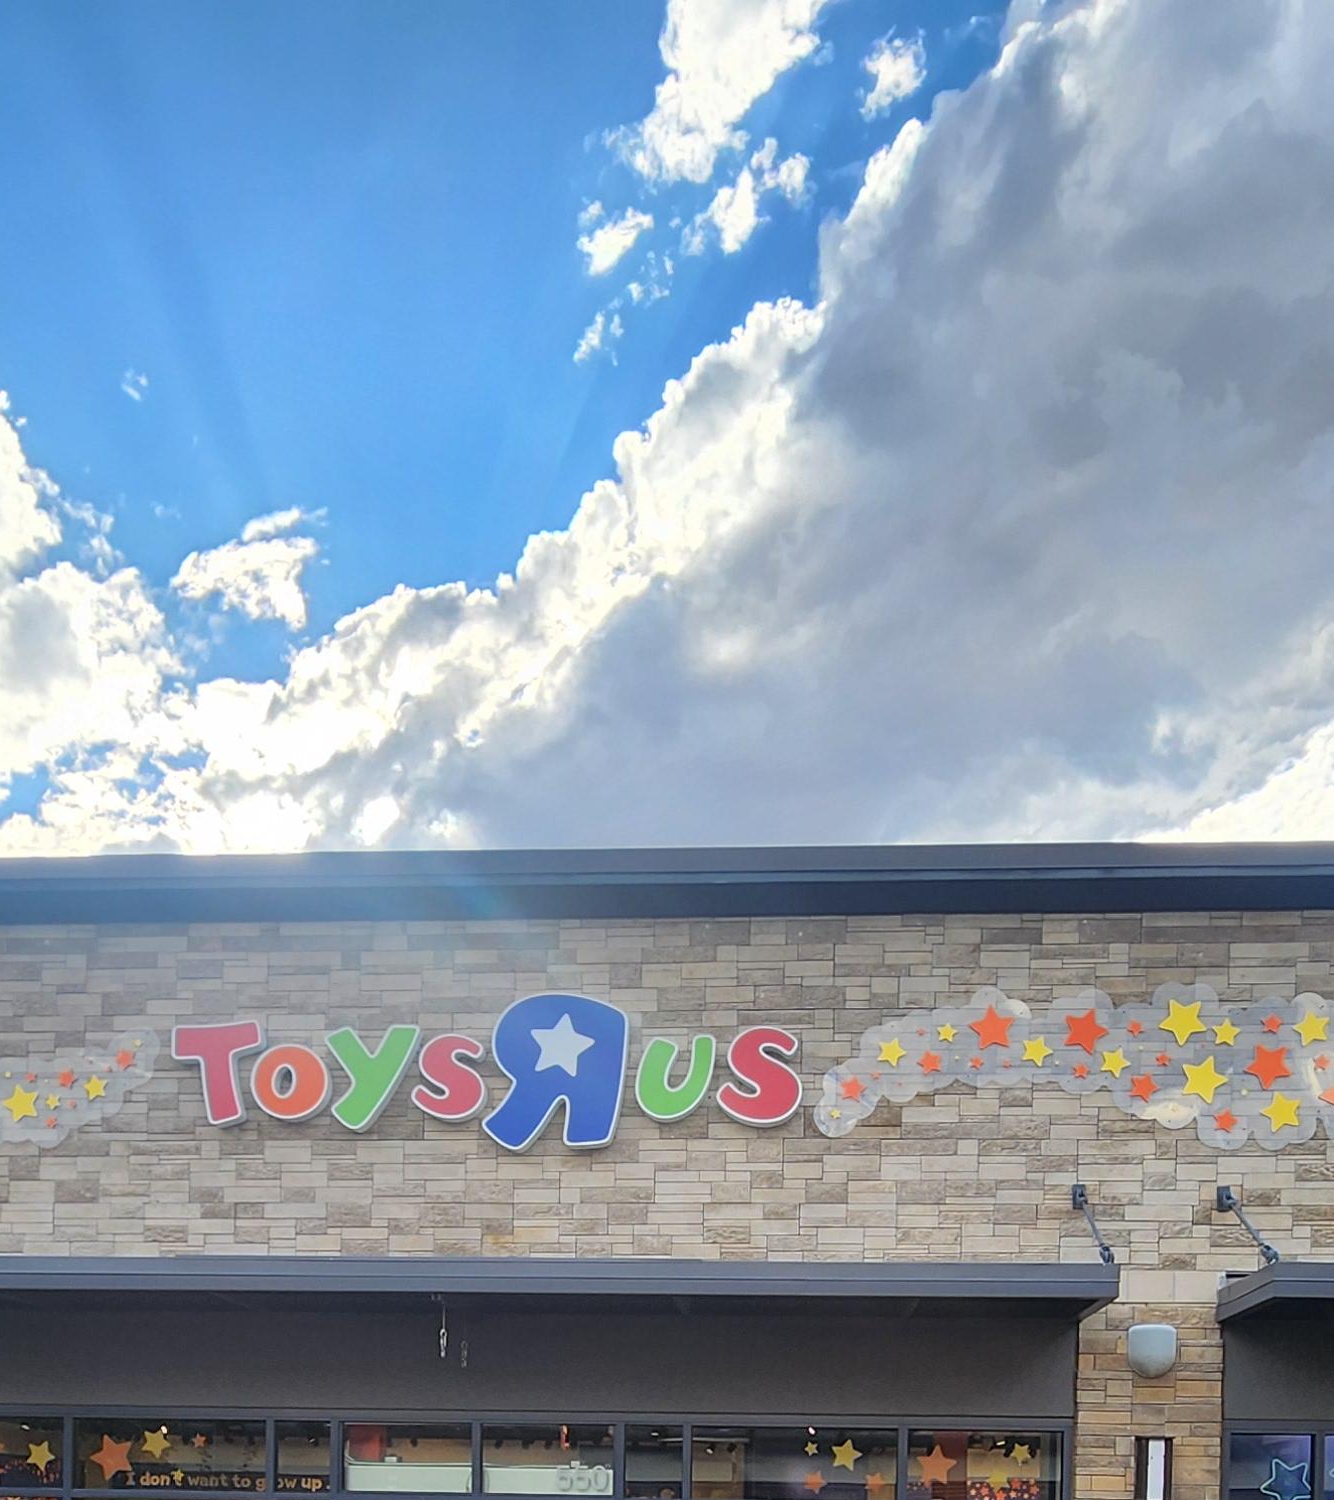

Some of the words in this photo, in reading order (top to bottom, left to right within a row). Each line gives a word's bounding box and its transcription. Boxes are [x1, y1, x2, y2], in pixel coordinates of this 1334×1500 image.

[188, 1473, 228, 1487] want
[232, 1474, 251, 1488] to
[255, 1477, 297, 1492] gow
